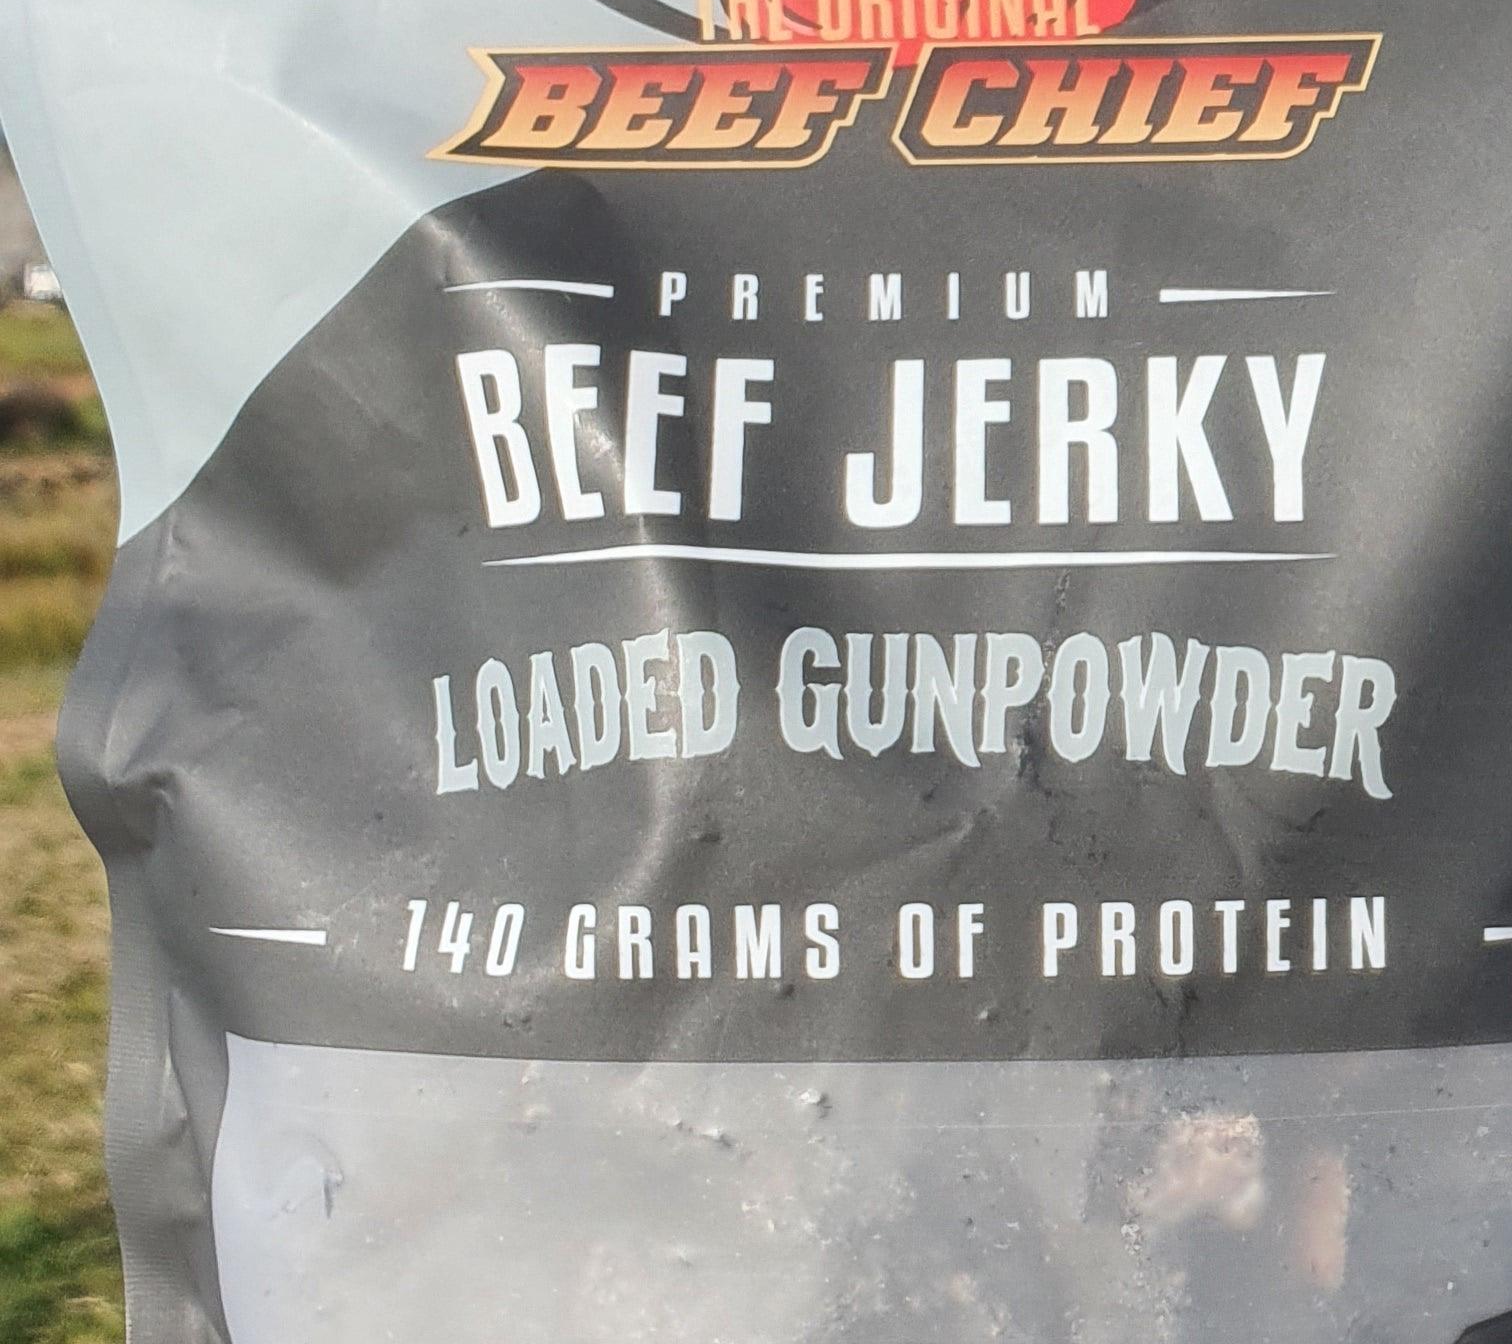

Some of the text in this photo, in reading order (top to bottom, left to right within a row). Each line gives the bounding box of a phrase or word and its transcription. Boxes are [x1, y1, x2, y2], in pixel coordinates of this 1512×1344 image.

[484, 53, 1354, 151] BEEF CHIEF
[659, 269, 1109, 322] PREMIUM
[457, 343, 1327, 528] BEEF JERKY
[434, 625, 1398, 801] LOADED GUNPOWDER
[401, 894, 1389, 981] 140 GRAMS OF PROTEIN
